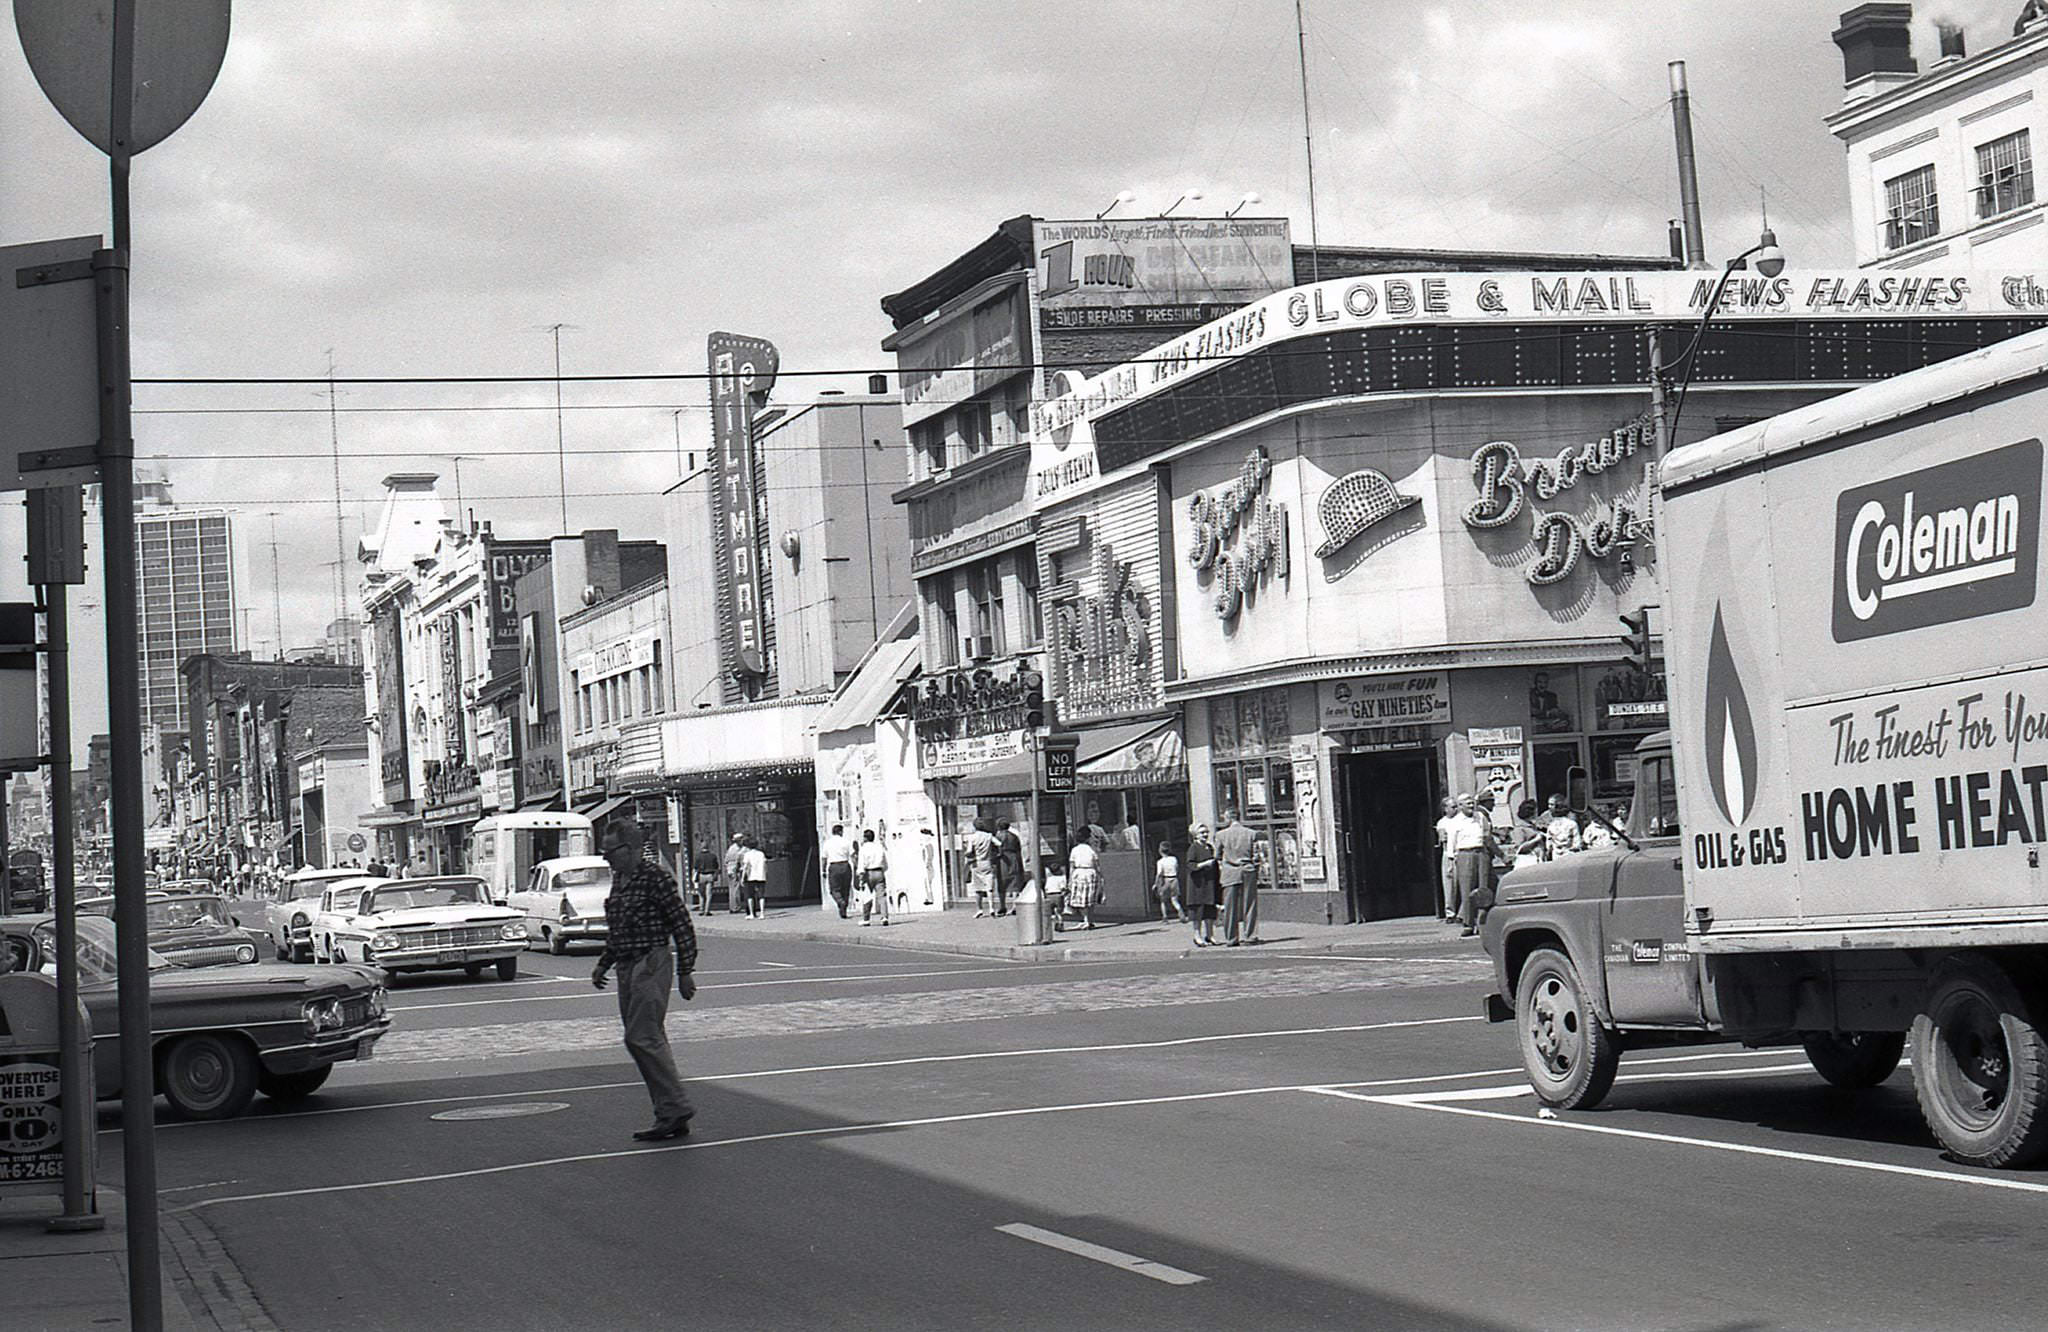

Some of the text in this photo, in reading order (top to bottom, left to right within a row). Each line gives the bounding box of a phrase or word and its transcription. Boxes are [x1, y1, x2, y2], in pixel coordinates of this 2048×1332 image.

[1041, 240, 1135, 300] 1 HOUR
[1056, 310, 1085, 327] SHOE
[1088, 308, 1134, 324] REPAIRS
[1287, 278, 1451, 327] GLOBE
[1476, 279, 1507, 313] &
[1531, 277, 1653, 313] MAIL
[1688, 278, 1791, 308] NEWS
[1806, 277, 1970, 307] FLASHES
[1151, 340, 1191, 384] NEWS
[1196, 306, 1267, 365] FLASHES
[714, 351, 754, 649] BILTMORE
[1846, 491, 2020, 620] Coleman
[1407, 677, 1438, 692] FUN
[1830, 711, 1870, 767] The
[1874, 703, 1952, 761] Finest
[1957, 692, 1997, 751] For
[205, 719, 217, 817] ZANZIBAR
[1048, 766, 1073, 777] LEFT
[1051, 753, 1069, 765] NO
[1048, 778, 1073, 788] TURN
[1801, 780, 1921, 862] HOME
[1695, 826, 1788, 869] OIL & GAS
[2, 1085, 46, 1099] HERE
[3, 1106, 46, 1118] ONLY
